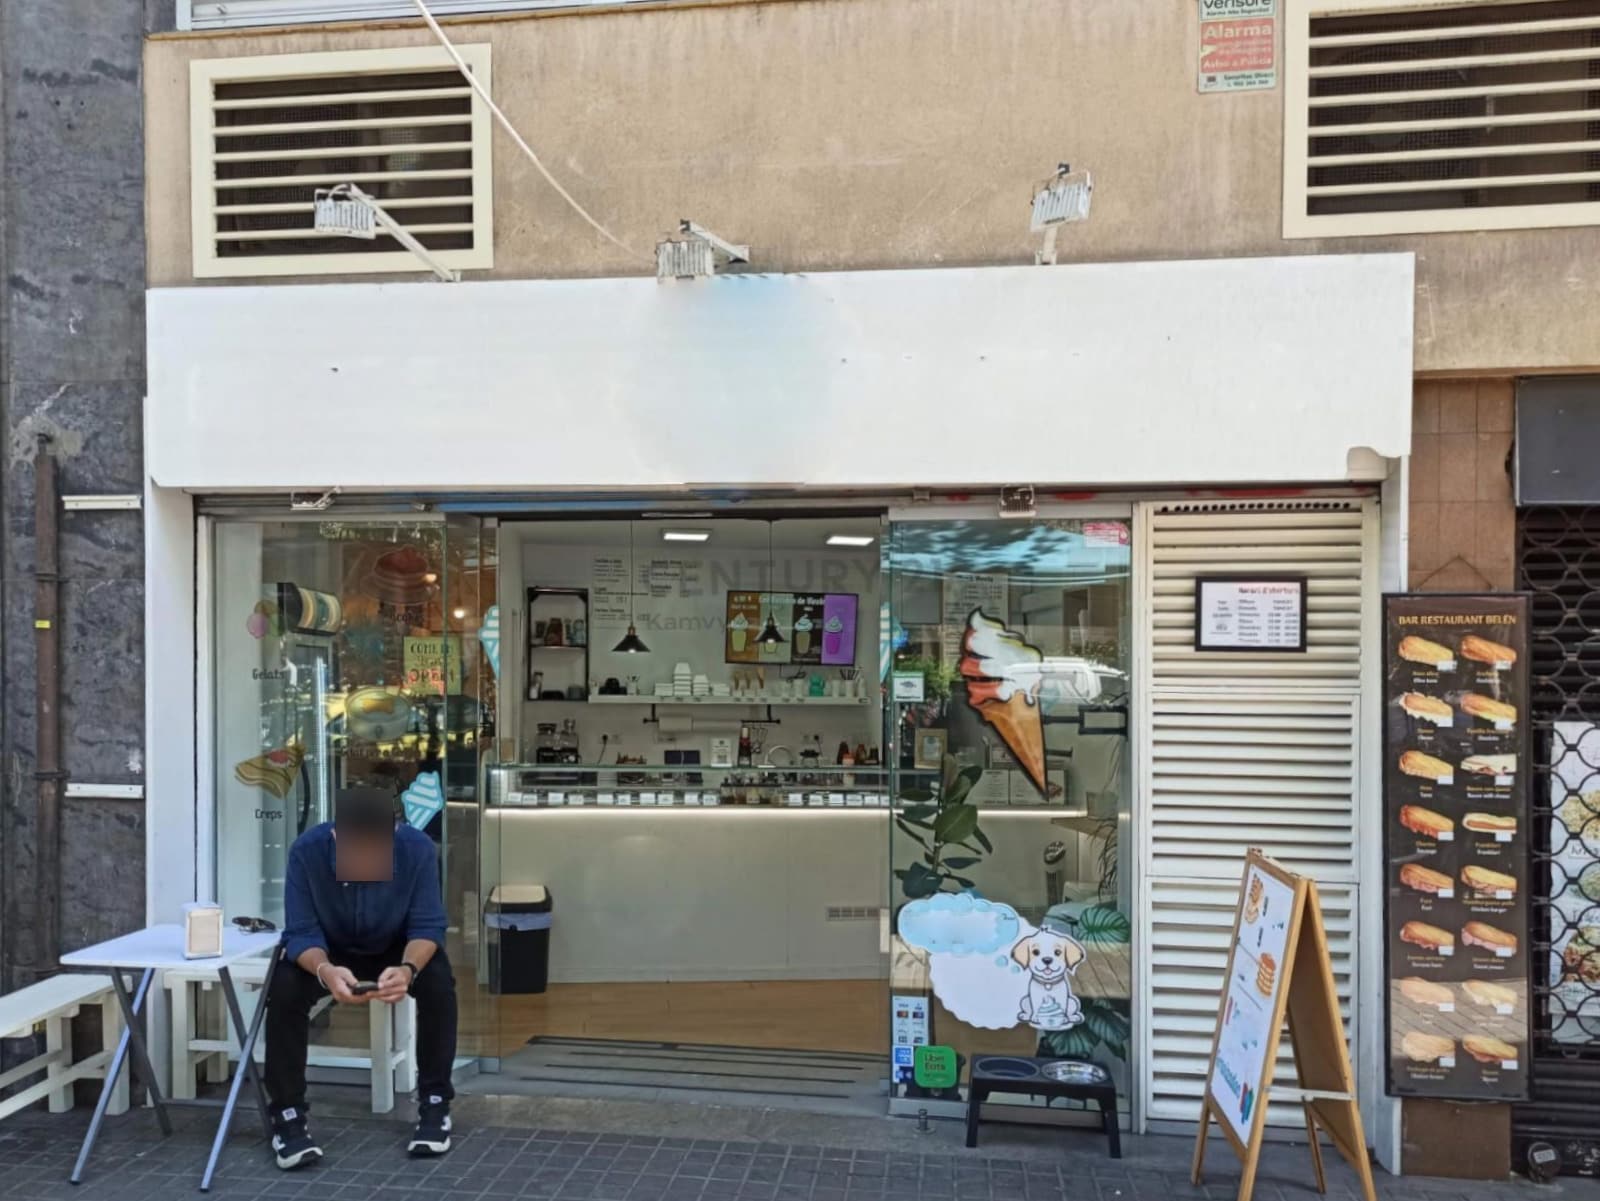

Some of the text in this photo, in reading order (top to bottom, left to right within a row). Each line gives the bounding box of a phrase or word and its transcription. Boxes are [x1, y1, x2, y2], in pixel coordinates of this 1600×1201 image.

[1206, 24, 1272, 39] Alarma
[1398, 615, 1418, 625] BAR
[1420, 615, 1484, 625] RESTAURANT
[253, 668, 284, 681] Gelats
[255, 808, 282, 822] Creps
[924, 1062, 946, 1071] Eats
